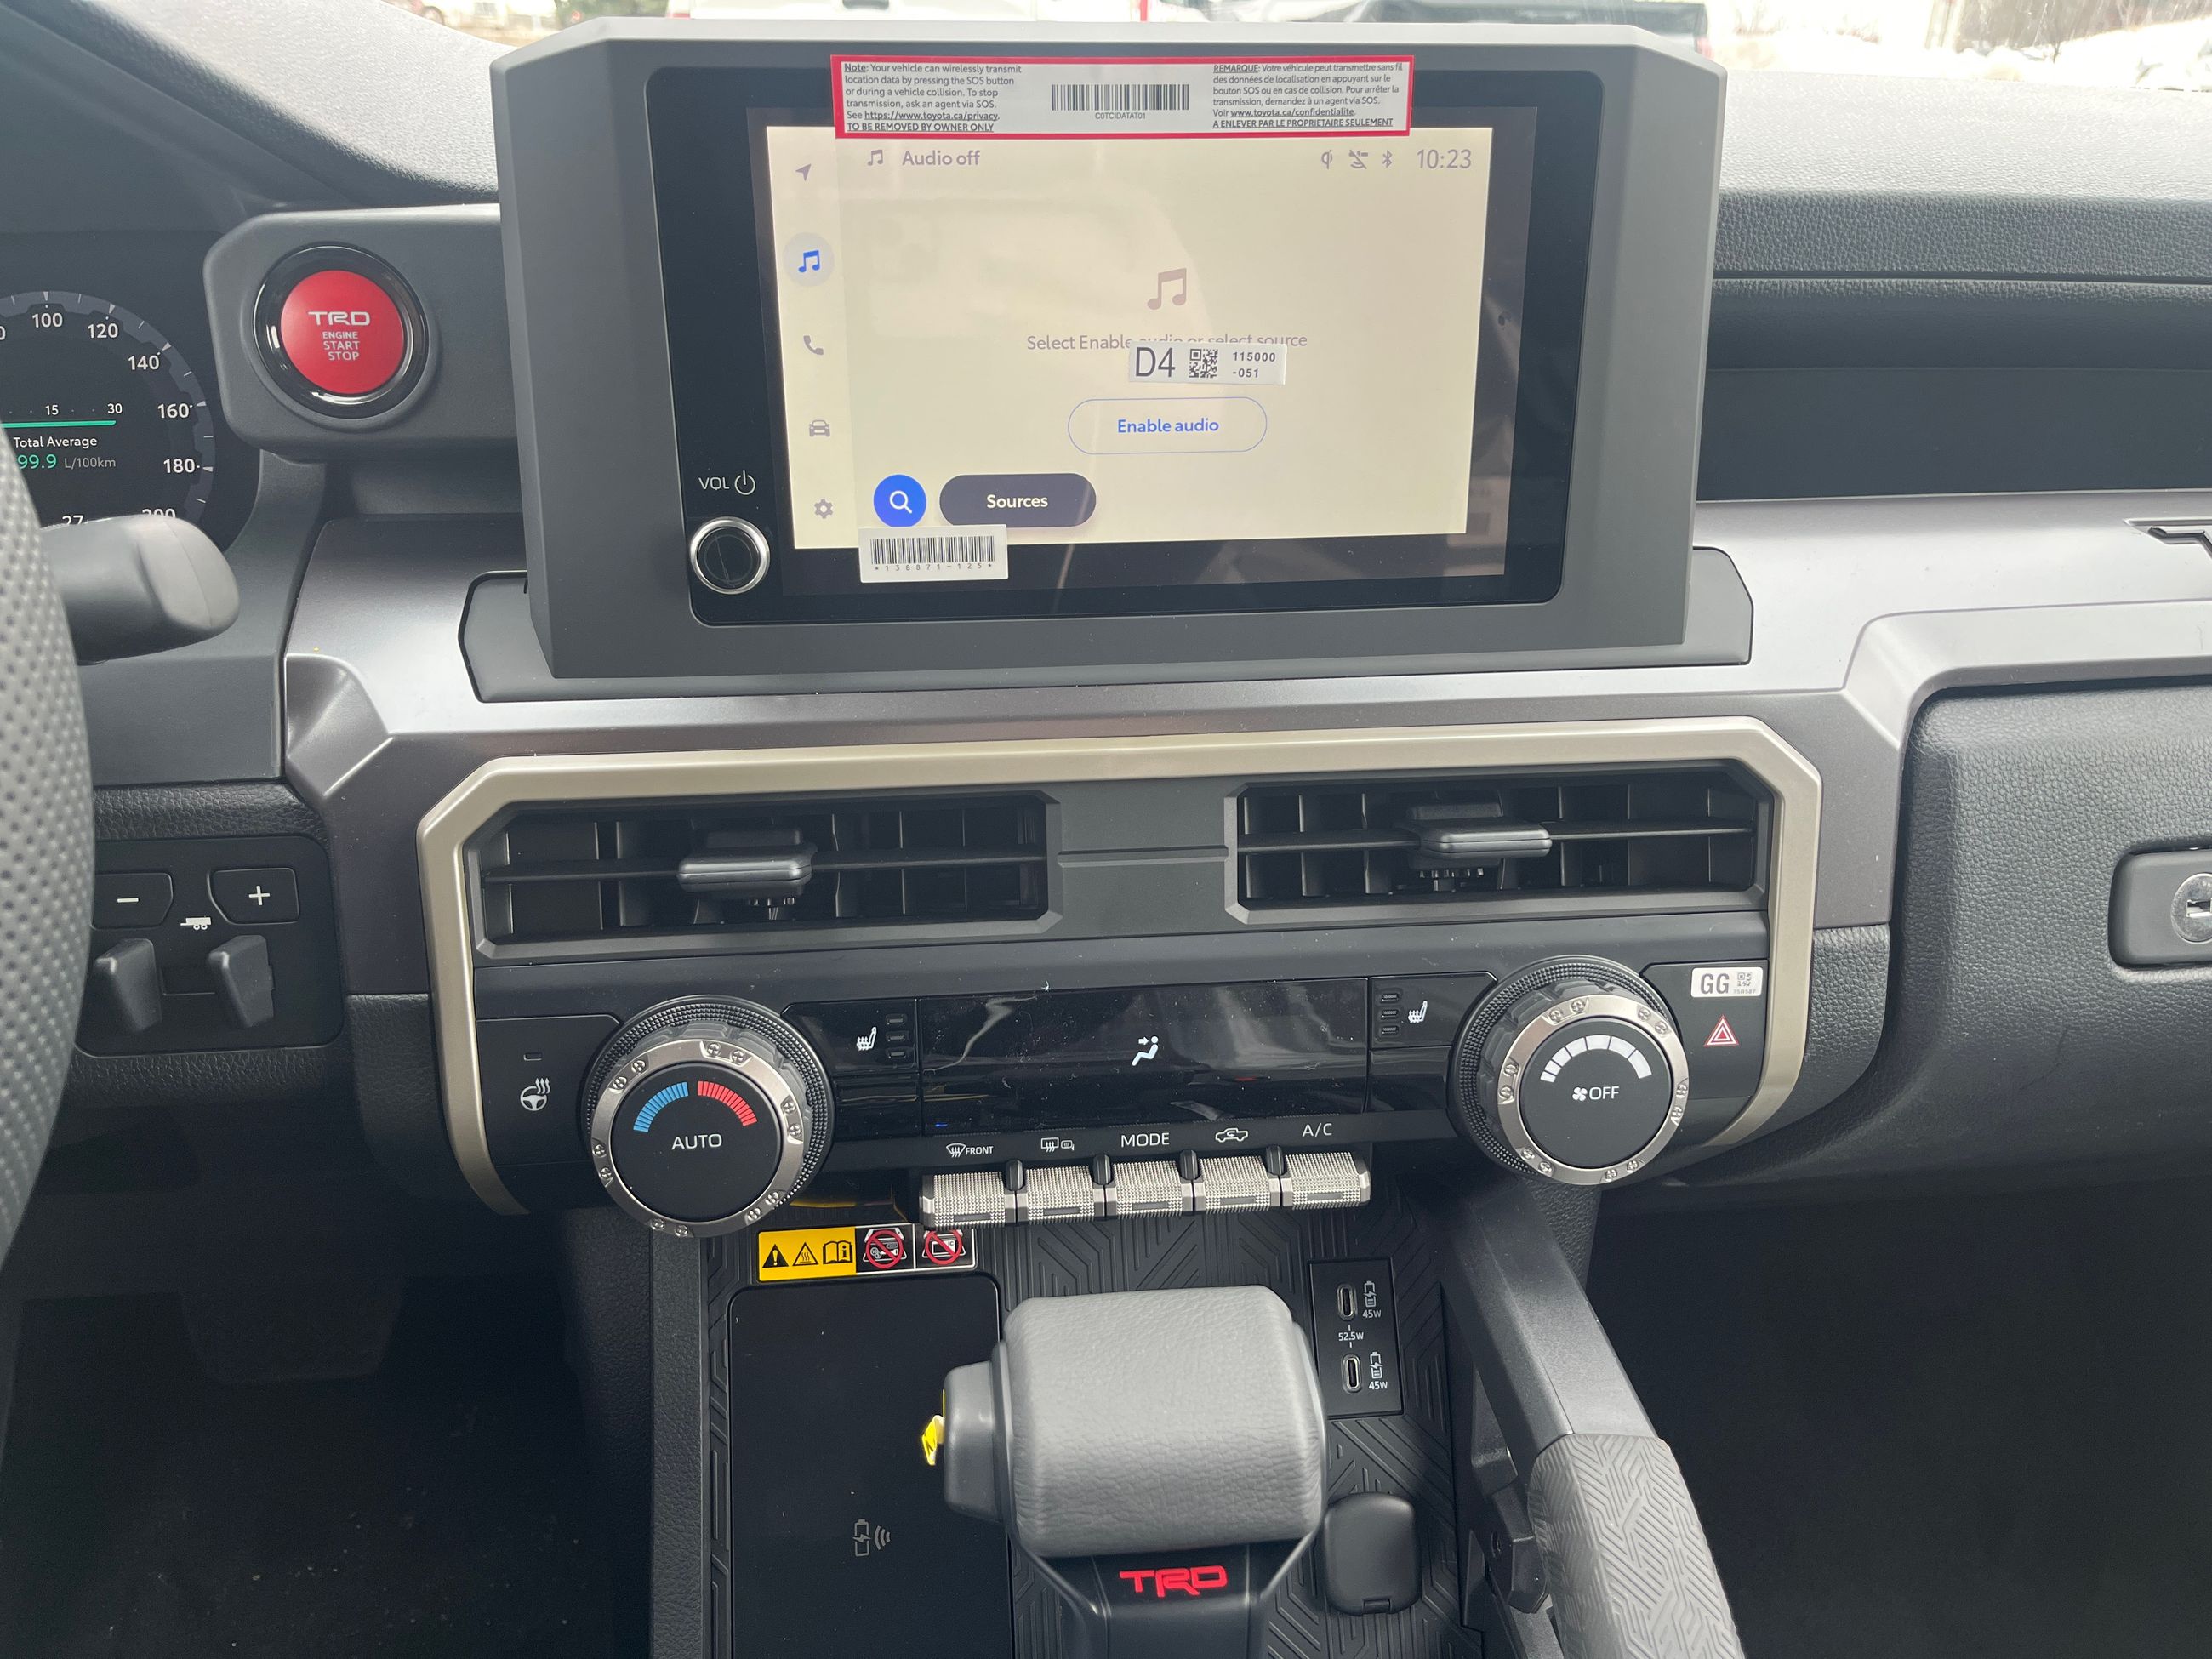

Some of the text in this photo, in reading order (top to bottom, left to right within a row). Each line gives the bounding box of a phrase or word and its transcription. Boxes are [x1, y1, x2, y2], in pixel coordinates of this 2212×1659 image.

[845, 64, 869, 73] Note:
[892, 64, 922, 73] vehicle
[943, 65, 983, 74] wirelessly
[1214, 65, 1260, 73] REMARQUE:
[1283, 64, 1312, 72] véhicule
[1314, 65, 1331, 73] peut
[845, 76, 879, 84] location
[881, 76, 899, 84] data
[902, 76, 911, 86] by
[915, 77, 949, 87] pressing
[987, 77, 1014, 85] button
[1229, 75, 1262, 83] données
[1276, 75, 1319, 83] localisation
[1332, 76, 1368, 84] appuyant
[857, 88, 885, 97] during
[894, 88, 924, 96] vehicle
[927, 88, 965, 97] collision.
[979, 89, 998, 99] stop
[1213, 87, 1240, 95] bouton
[847, 100, 903, 109] transmission,
[935, 101, 960, 110] agent
[976, 100, 996, 109] SOS.
[1213, 98, 1263, 107] transmission,
[1265, 97, 1305, 105] demandez
[1325, 98, 1347, 106] agent
[864, 111, 1000, 121] https://www.toyota.ca/privacy.
[847, 123, 994, 133] TO BE REMOVED BY OWNER ONLY
[1221, 120, 1256, 128] ENLEVER
[1276, 119, 1285, 128] LE
[1287, 119, 1343, 128] PROPRIETAIRE
[1346, 118, 1393, 127] SEULEMENT
[902, 150, 980, 165] Audio off
[1417, 149, 1471, 168] 10:23
[32, 312, 63, 328] 100
[308, 311, 370, 326] TRD
[88, 323, 118, 339] 120
[323, 341, 360, 350] START
[1028, 335, 1075, 350] Select
[1080, 334, 1132, 349] Enable
[1257, 336, 1307, 346] source
[328, 351, 359, 361] STOP
[1136, 347, 1175, 377] D4
[1233, 352, 1275, 362] 115000
[128, 355, 160, 370] 140
[1233, 368, 1258, 378] -051
[46, 405, 59, 415] 15
[107, 403, 123, 414] 30
[158, 403, 189, 419] 160
[1118, 418, 1218, 433] Enable audio
[14, 436, 97, 449] Total Average
[17, 453, 116, 469] 99.9 L/100km
[163, 459, 195, 473] 180
[698, 476, 729, 491] VOL
[986, 494, 1048, 509] Sources
[1701, 973, 1729, 994] GG
[1589, 1086, 1620, 1100] OFF
[1303, 1122, 1333, 1137] A/C
[672, 1133, 722, 1150] AUTO
[1120, 1132, 1170, 1148] MODE
[965, 1144, 994, 1156] FRONT
[1363, 1309, 1382, 1318] 45W
[1338, 1331, 1364, 1341] 52.5W
[1369, 1381, 1388, 1390] 45W
[1119, 1565, 1228, 1598] TRD
